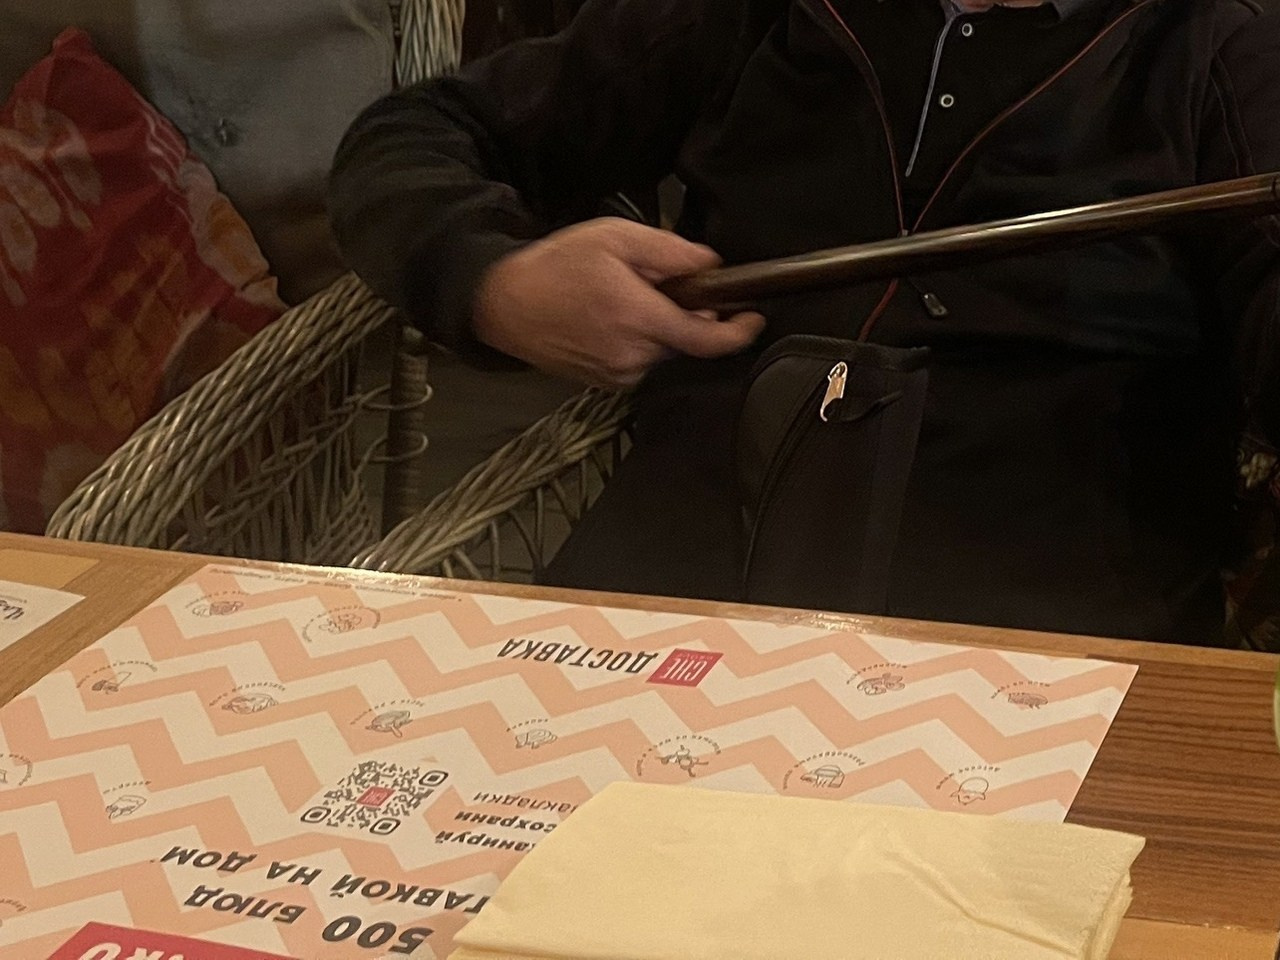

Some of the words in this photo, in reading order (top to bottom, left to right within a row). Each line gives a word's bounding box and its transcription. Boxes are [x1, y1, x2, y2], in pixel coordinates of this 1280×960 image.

[497, 638, 660, 674] ДОСТАВКА
[266, 860, 323, 887] НА
[184, 884, 308, 924] БЛЮД
[322, 915, 434, 955] 500
